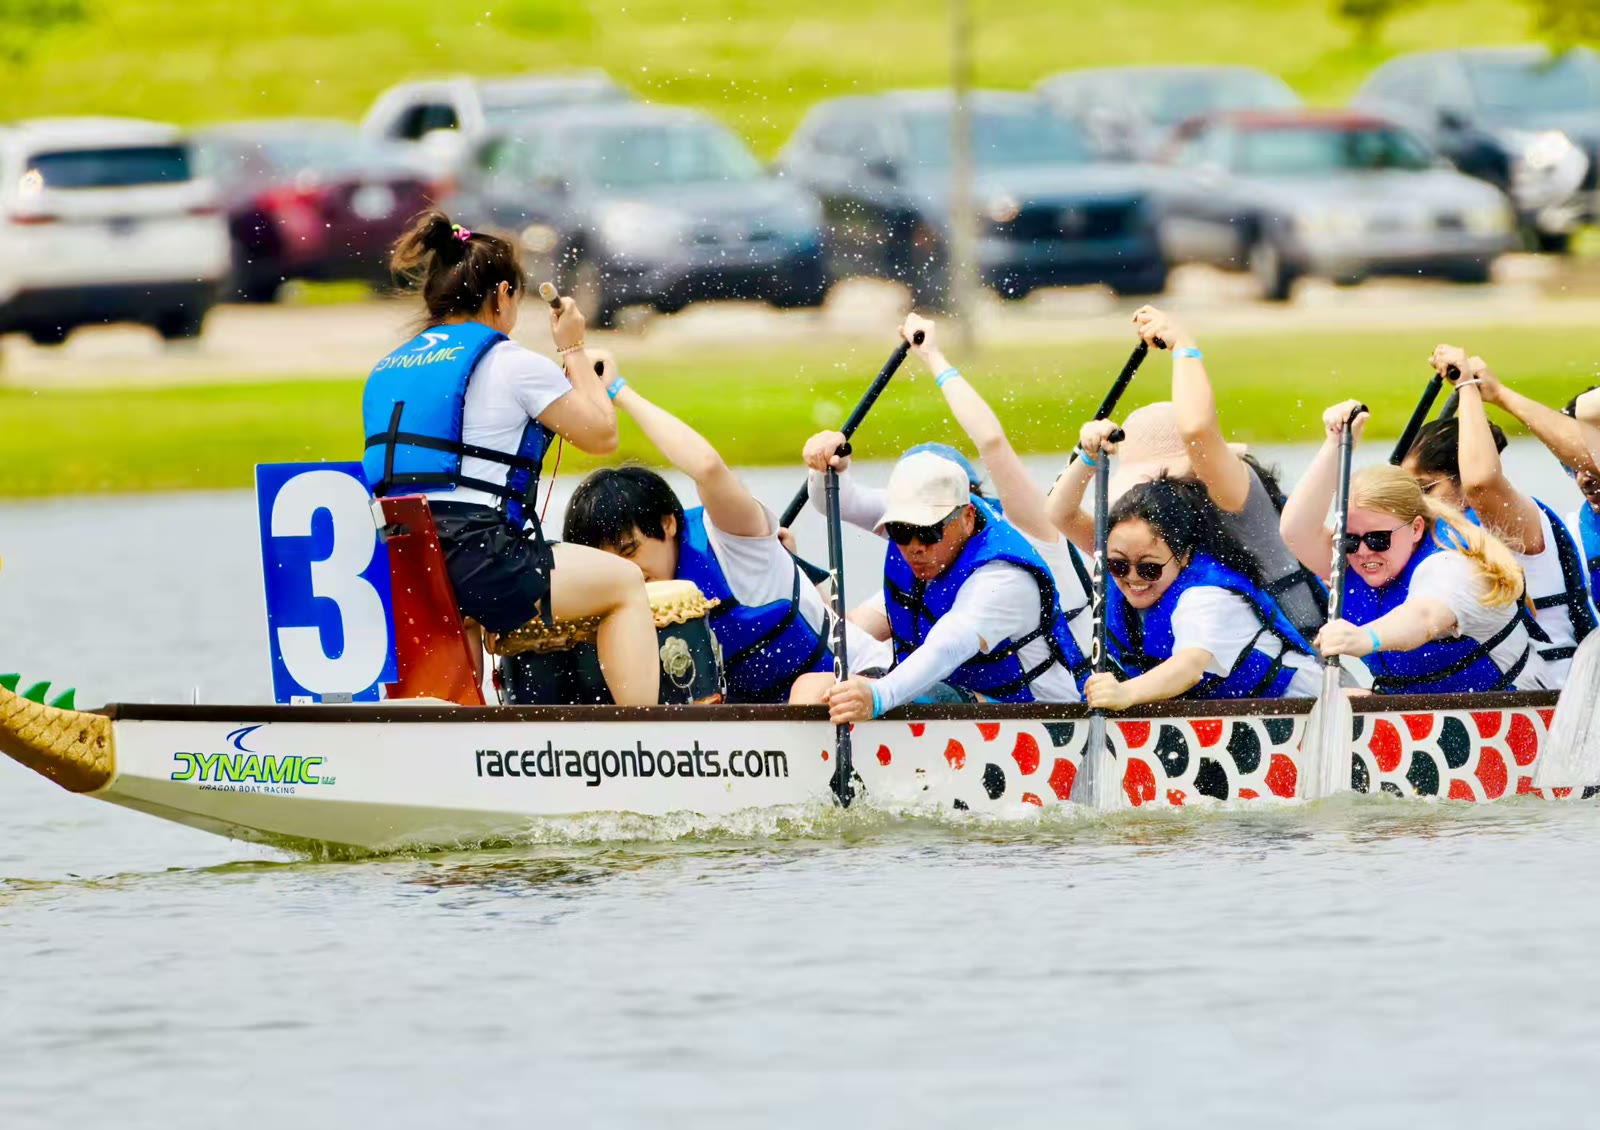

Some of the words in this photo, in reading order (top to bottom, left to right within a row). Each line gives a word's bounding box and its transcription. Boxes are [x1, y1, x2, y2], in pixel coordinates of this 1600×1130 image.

[375, 346, 464, 371] DYNAMIC
[271, 470, 388, 695] 3
[1327, 511, 1343, 619] KIALO
[829, 568, 842, 685] KIALO
[1091, 551, 1103, 672] KIALO
[171, 752, 323, 785] DYNAMIC
[264, 786, 296, 794] RACING
[475, 740, 789, 787] racedragonboats.com
